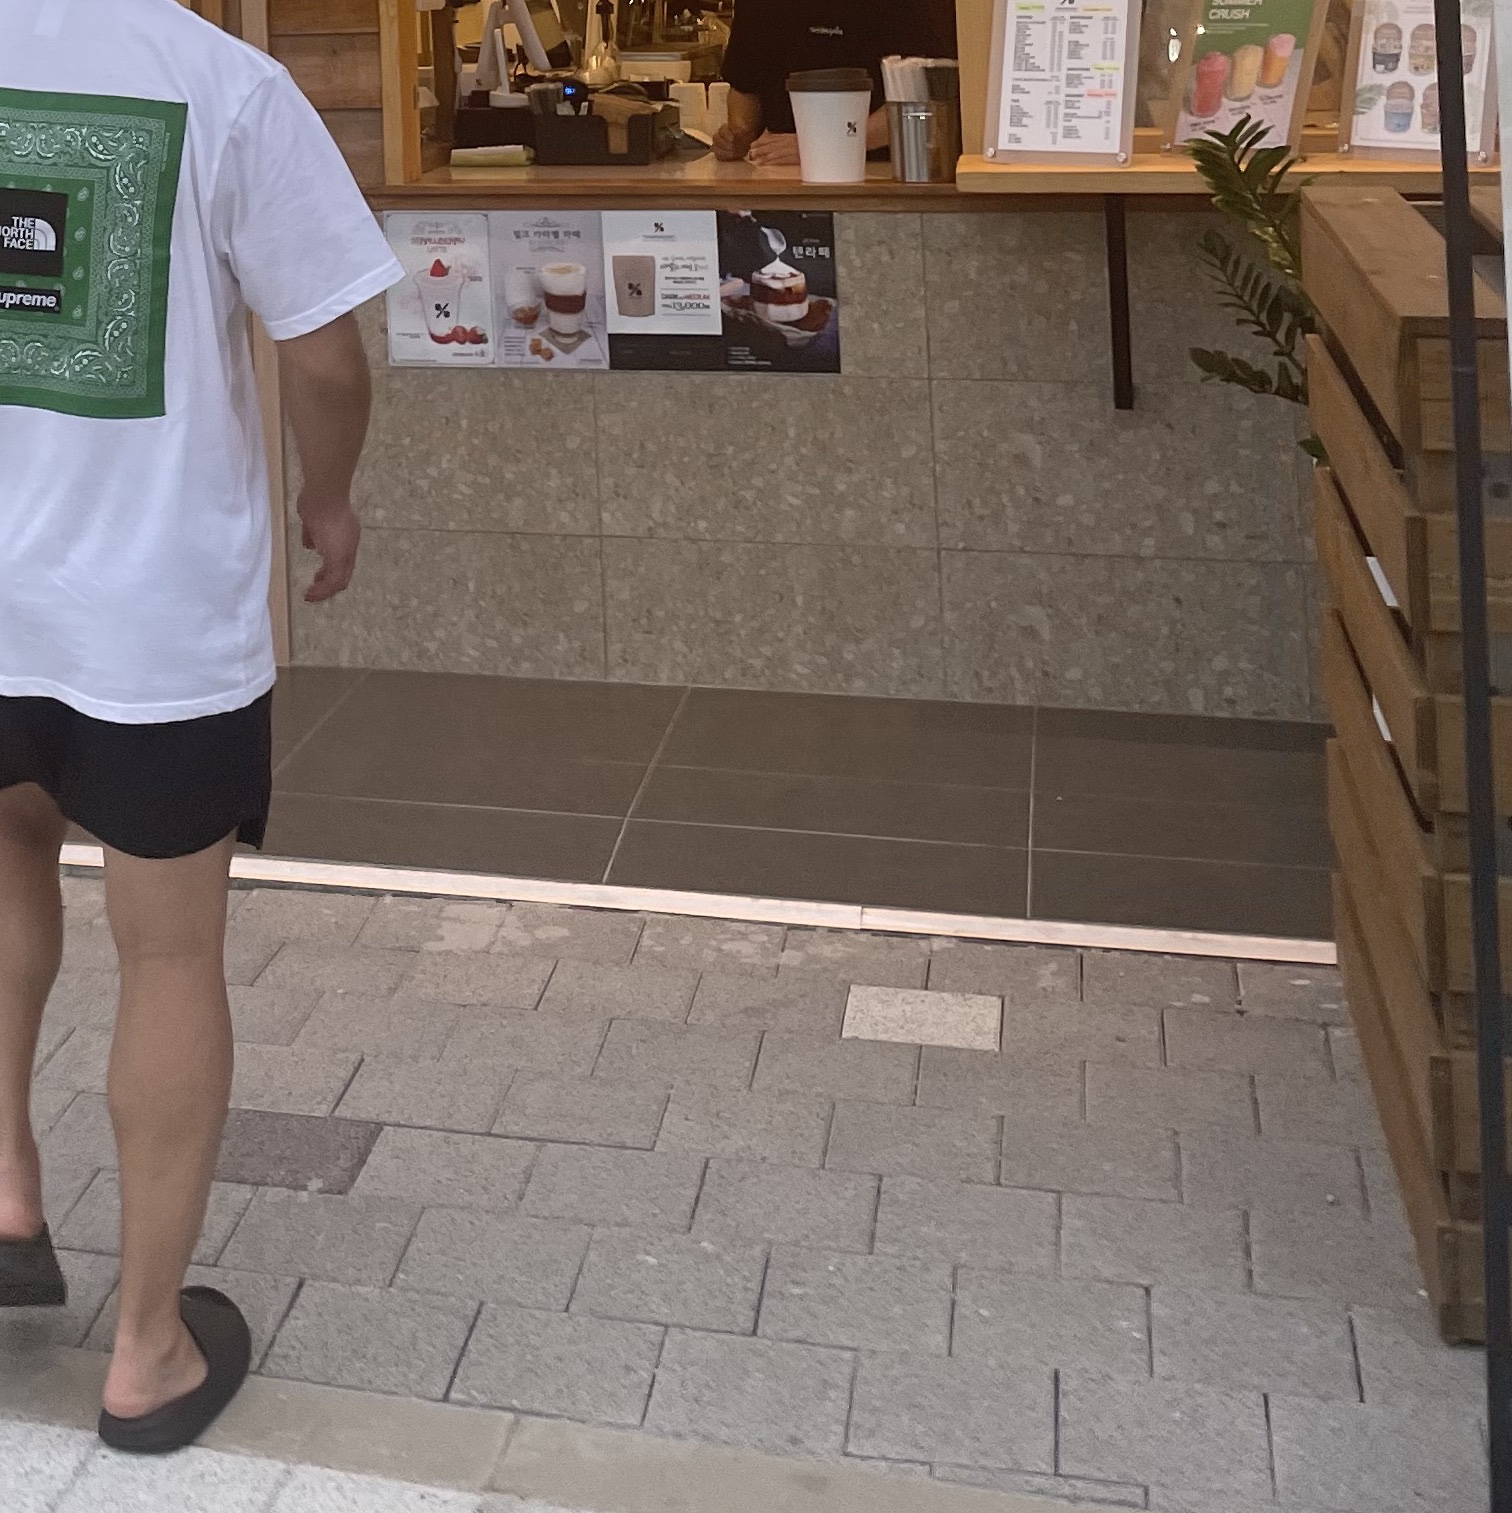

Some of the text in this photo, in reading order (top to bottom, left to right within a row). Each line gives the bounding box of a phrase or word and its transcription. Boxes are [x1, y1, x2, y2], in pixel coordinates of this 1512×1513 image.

[1208, 9, 1251, 19] CRUSH
[11, 216, 35, 229] THE
[3, 237, 34, 251] FACE
